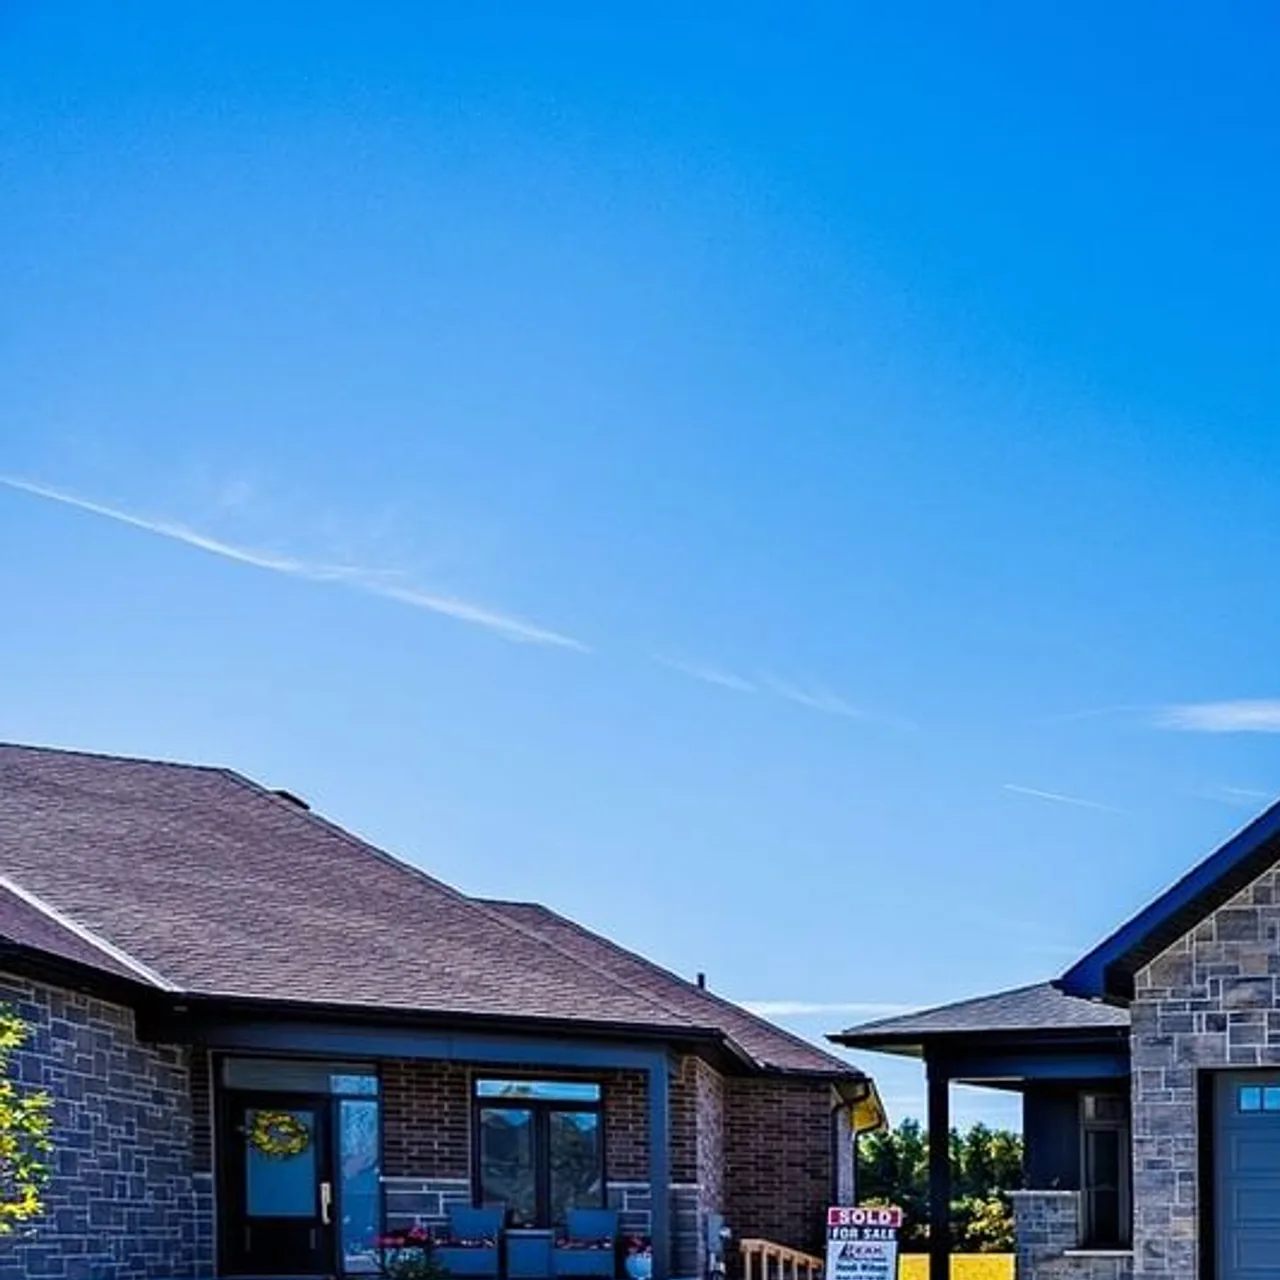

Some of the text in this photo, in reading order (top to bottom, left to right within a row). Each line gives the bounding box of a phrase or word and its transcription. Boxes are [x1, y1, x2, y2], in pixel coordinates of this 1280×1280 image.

[839, 1210, 892, 1225] SOLD
[832, 1228, 895, 1240] FOR SALE
